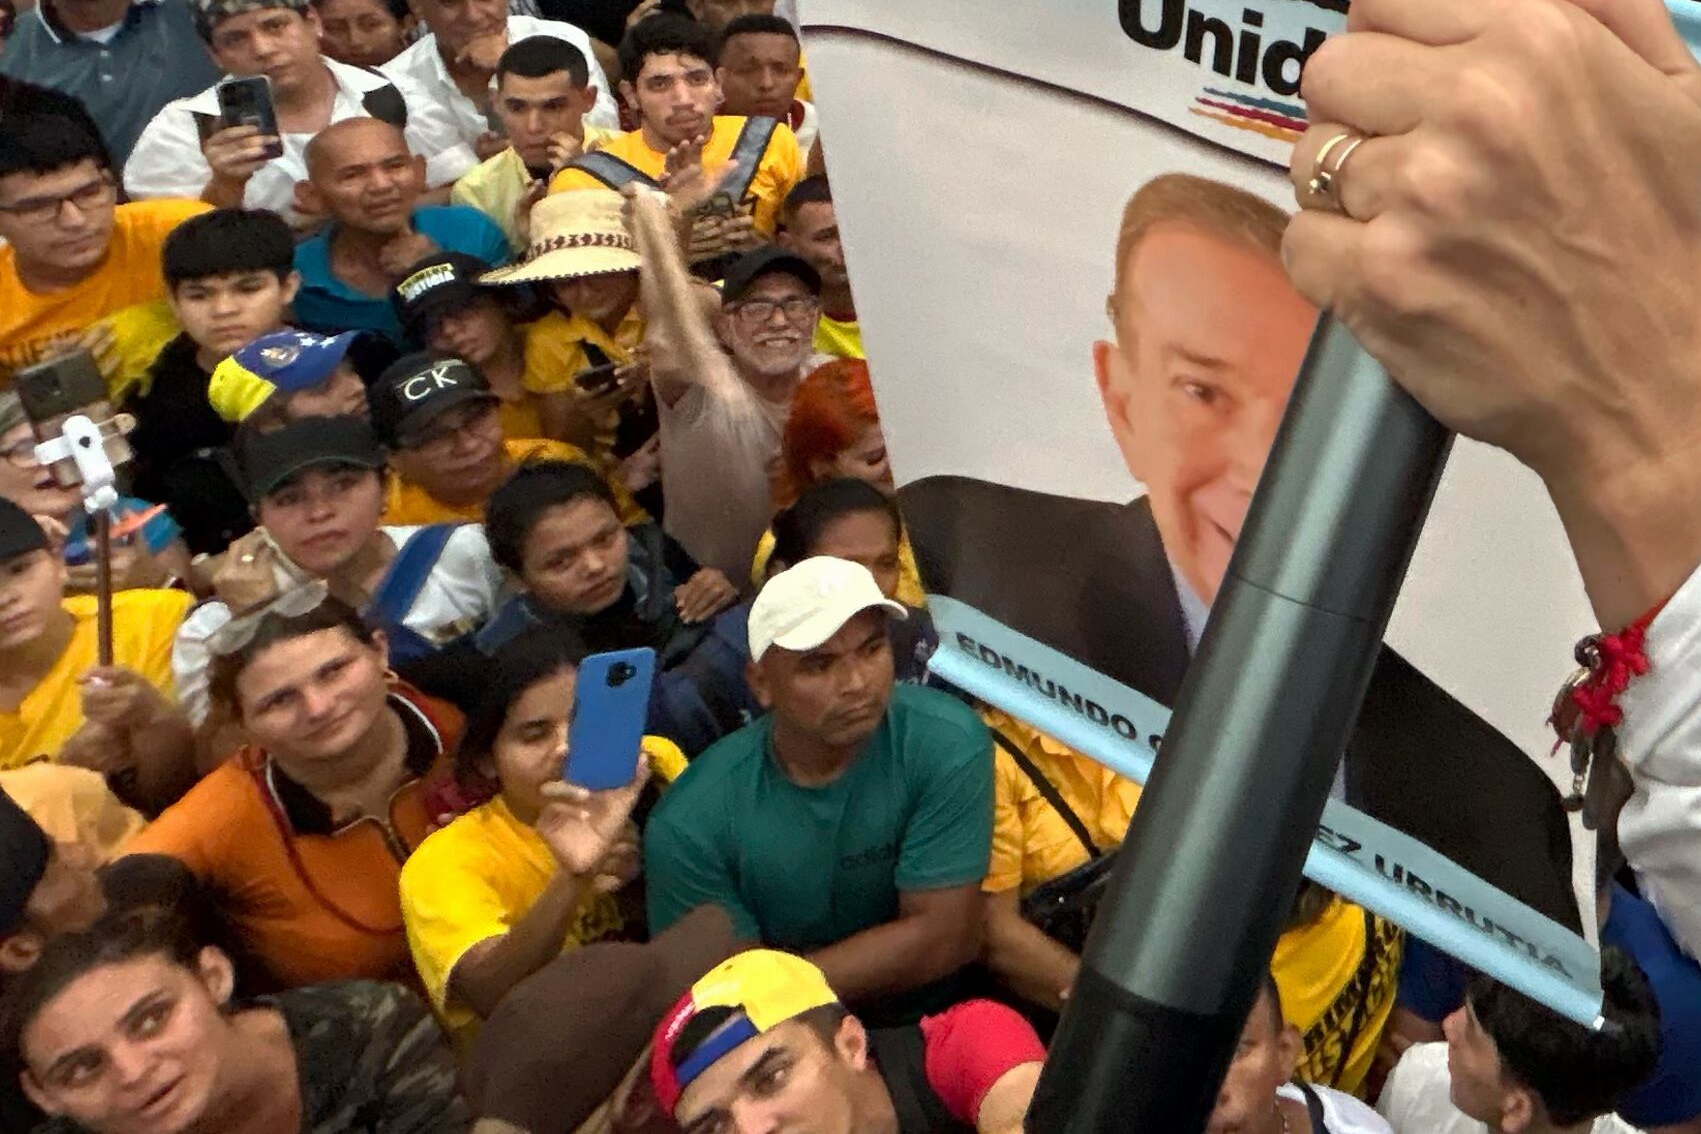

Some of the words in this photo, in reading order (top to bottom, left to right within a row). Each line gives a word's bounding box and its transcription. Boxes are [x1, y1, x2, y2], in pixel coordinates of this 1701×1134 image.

[404, 366, 458, 400] CK
[956, 631, 1137, 741] EDMUNDO
[1374, 853, 1574, 979] URRUTIA
